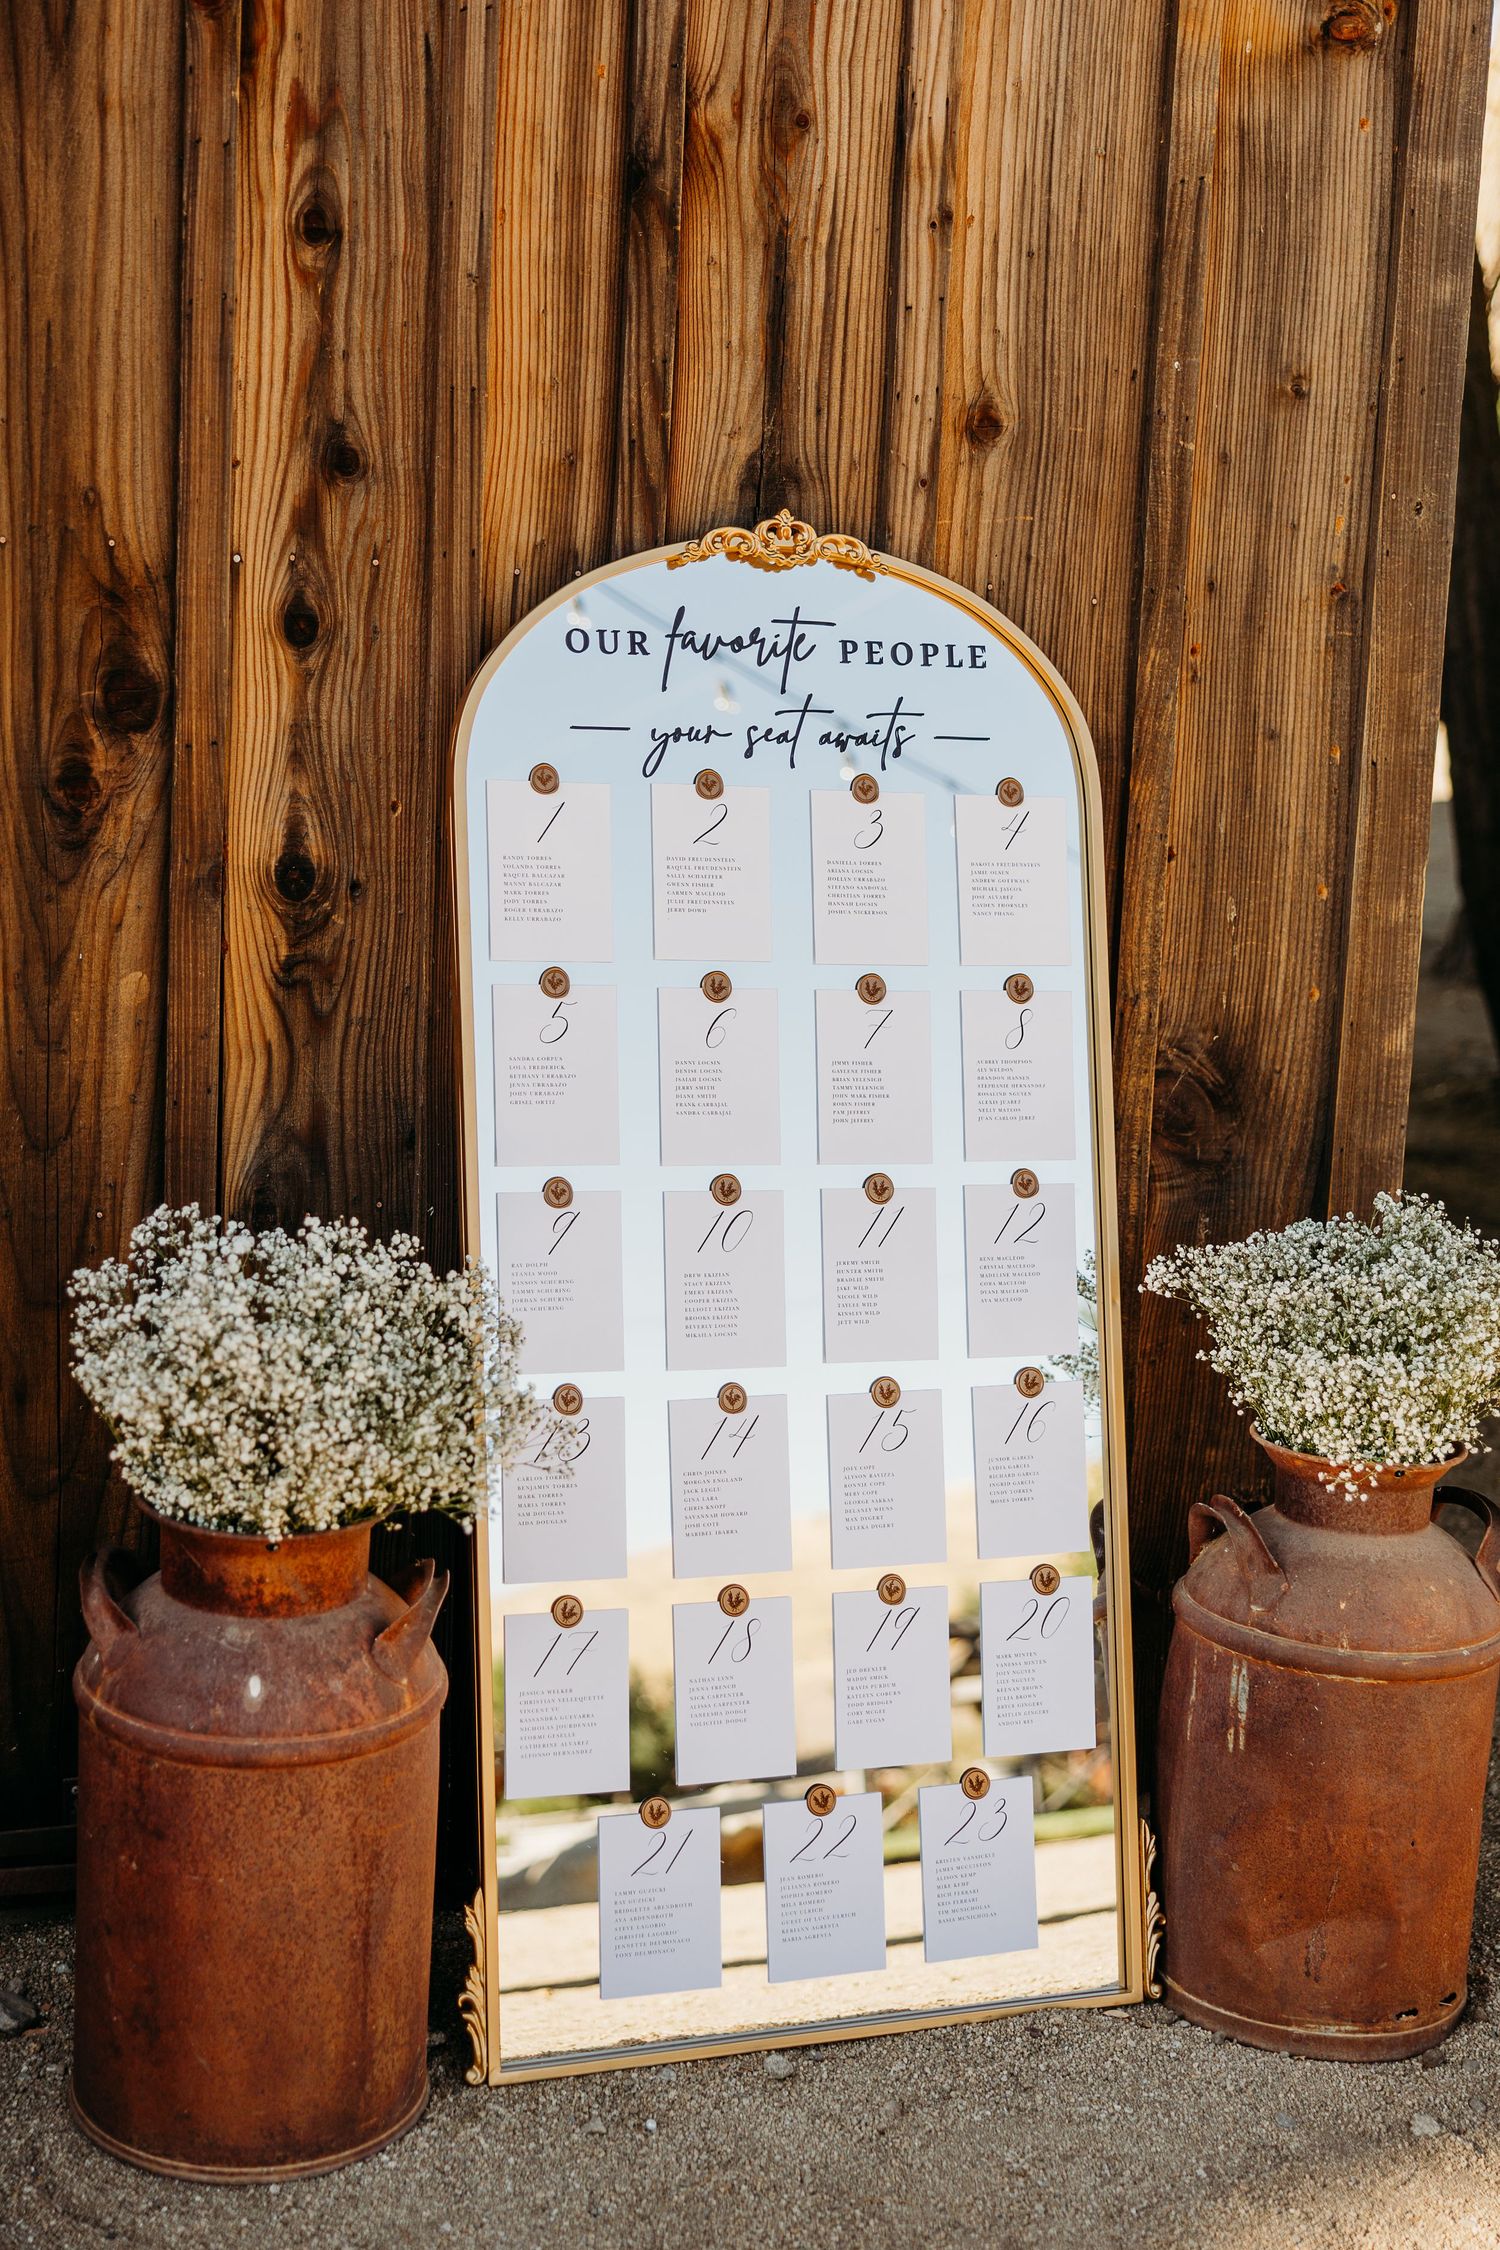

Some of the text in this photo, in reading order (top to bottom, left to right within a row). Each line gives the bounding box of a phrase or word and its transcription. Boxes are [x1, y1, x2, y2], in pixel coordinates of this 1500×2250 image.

[565, 605, 988, 693] OUR favorite PEOPLE
[643, 693, 924, 778] your seat awaits
[537, 802, 565, 843] 1
[693, 804, 728, 846] 2
[854, 810, 884, 849] 3
[1001, 811, 1030, 850] 4
[539, 1002, 578, 1044] 5
[705, 1008, 736, 1048] 6
[864, 1010, 894, 1048] 7
[1004, 1008, 1034, 1050] 8
[548, 1211, 580, 1255] 9
[698, 1210, 754, 1253] 10
[858, 1206, 904, 1248] 11
[994, 1202, 1046, 1244] 12
[534, 1418, 591, 1464] 13
[701, 1415, 760, 1460] 14
[858, 1408, 918, 1454] 15
[1004, 1400, 1056, 1444] 16
[989, 1472, 1016, 1480] RICHARD
[866, 1606, 921, 1652] 19
[1006, 1596, 1070, 1641] 20
[534, 1630, 599, 1678] 17
[708, 1618, 762, 1664] 18
[789, 1814, 857, 1864] 22
[944, 1798, 1008, 1846] 23
[630, 1828, 694, 1877] 21
